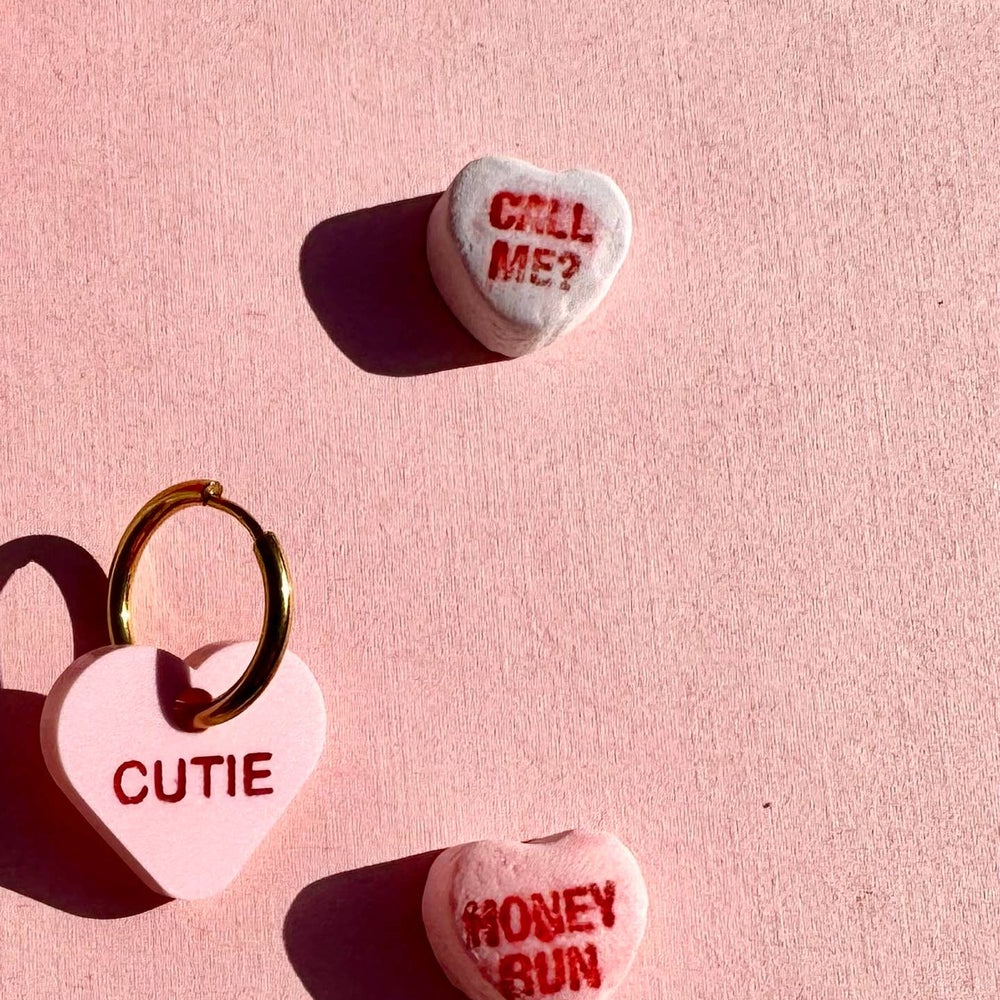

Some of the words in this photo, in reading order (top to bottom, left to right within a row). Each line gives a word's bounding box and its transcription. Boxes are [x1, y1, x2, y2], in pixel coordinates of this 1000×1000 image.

[489, 191, 593, 243] CALL
[488, 239, 582, 291] ME?
[113, 752, 274, 805] CUTIE
[462, 880, 617, 951] HONEY
[499, 943, 602, 1000] BUN
